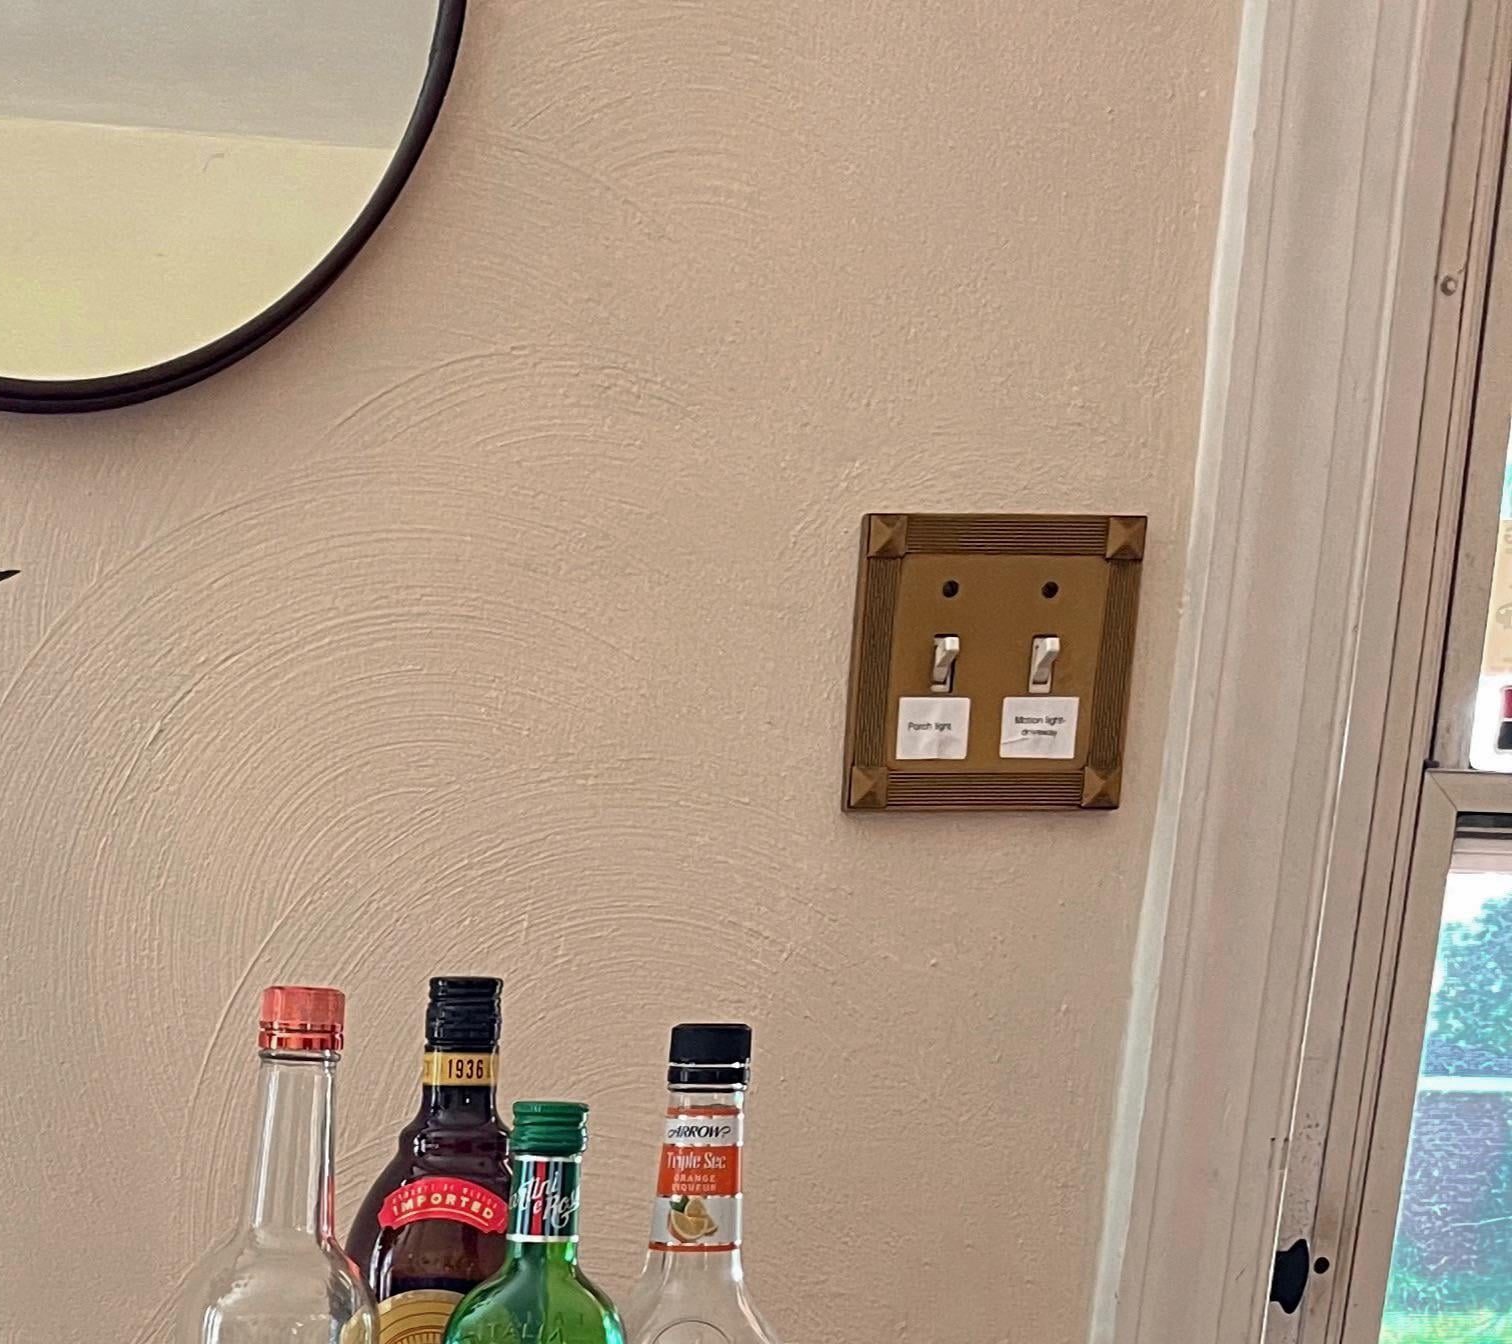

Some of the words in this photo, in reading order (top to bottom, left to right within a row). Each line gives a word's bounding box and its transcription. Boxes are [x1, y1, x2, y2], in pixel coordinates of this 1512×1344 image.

[935, 722, 952, 732] light
[448, 1058, 484, 1079] 1936
[666, 1149, 701, 1172] Triple
[703, 1151, 727, 1169] Sec
[392, 1192, 494, 1220] IMPORTED
